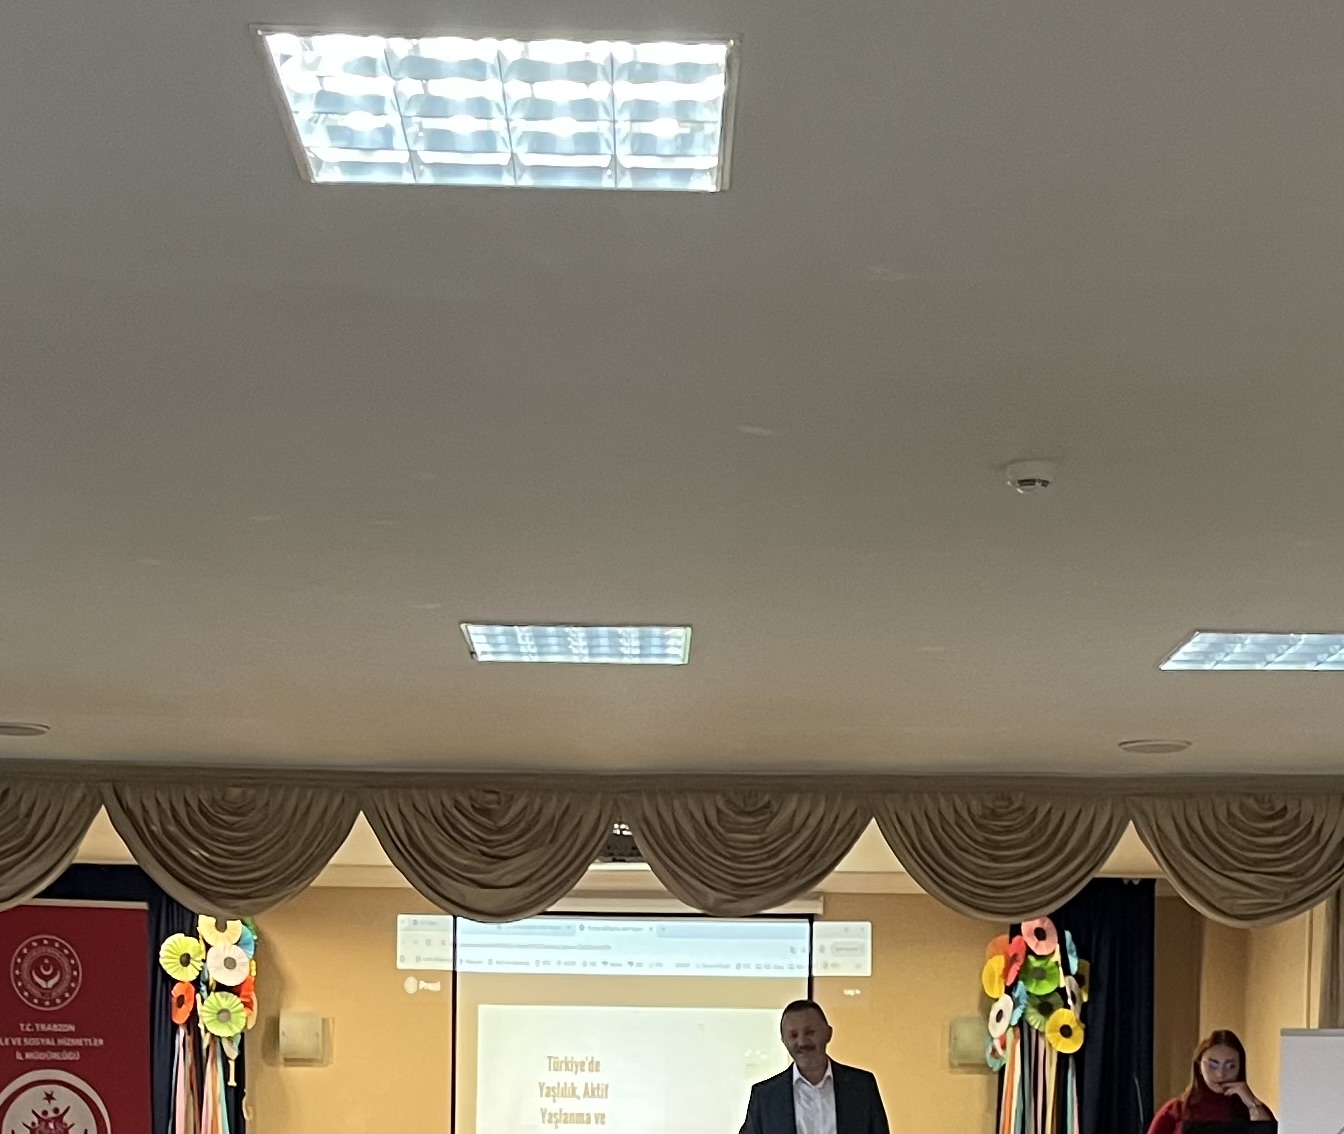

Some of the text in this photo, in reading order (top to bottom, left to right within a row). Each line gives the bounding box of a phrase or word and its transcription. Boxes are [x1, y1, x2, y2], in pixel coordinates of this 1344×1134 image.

[24, 1037, 56, 1046] SOSYAL
[546, 1055, 601, 1075] Türkiye'de
[582, 1081, 610, 1099] Aktif
[539, 1107, 607, 1129] Yaşlanma ve
